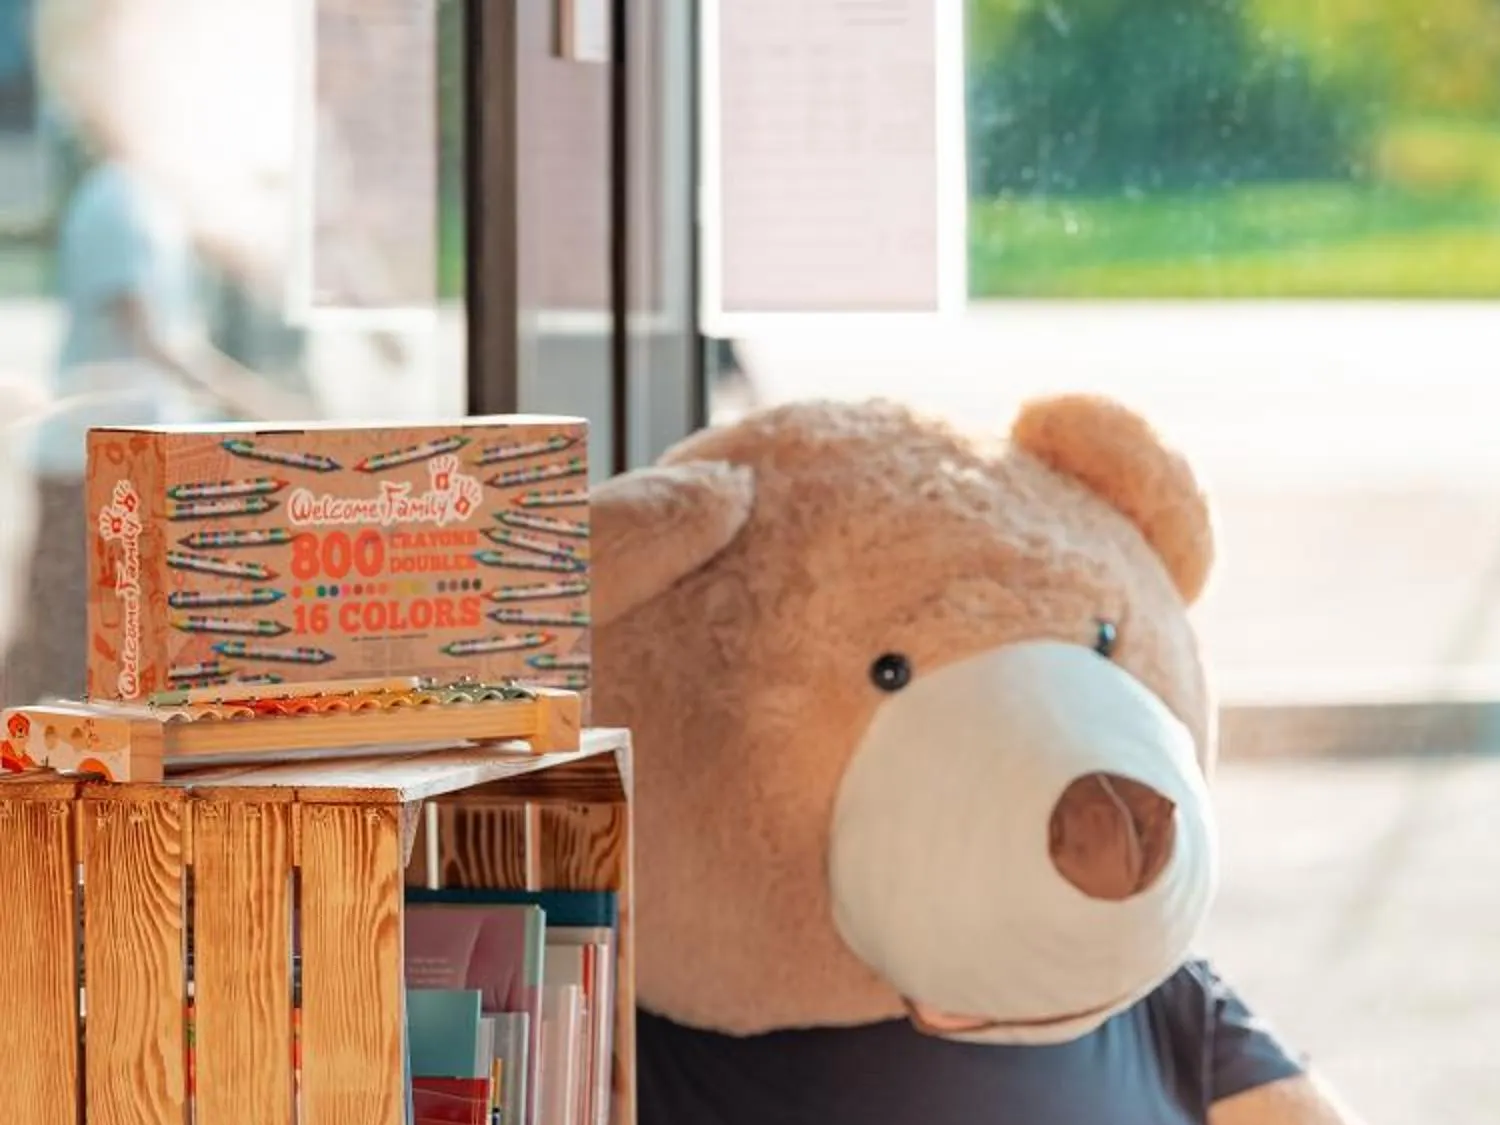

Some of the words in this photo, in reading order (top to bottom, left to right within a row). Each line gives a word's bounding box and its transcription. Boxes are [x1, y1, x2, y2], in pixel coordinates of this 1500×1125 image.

[291, 529, 385, 580] 800
[293, 602, 329, 635] 16
[339, 597, 481, 633] COLORS
